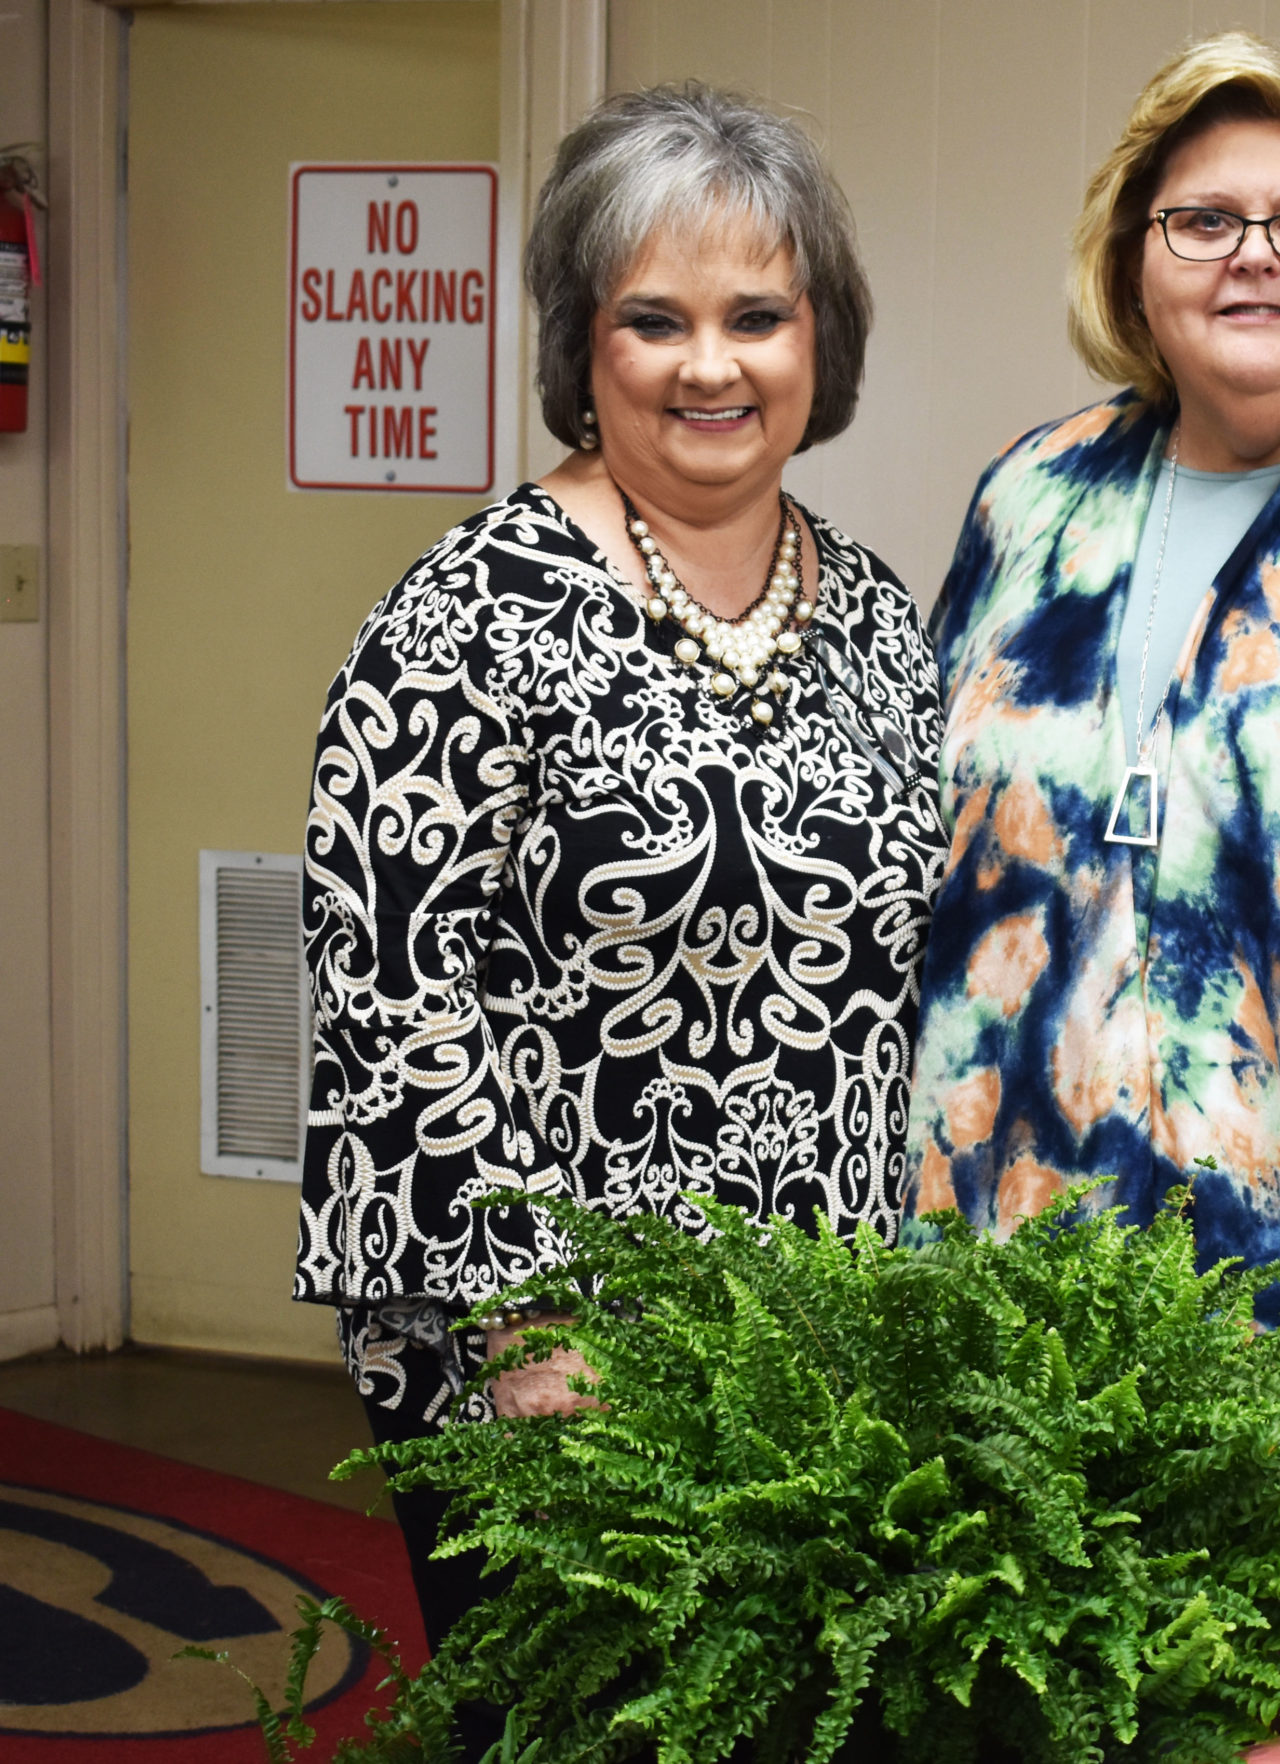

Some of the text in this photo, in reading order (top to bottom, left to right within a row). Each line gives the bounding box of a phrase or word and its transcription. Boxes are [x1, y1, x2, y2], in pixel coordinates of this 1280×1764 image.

[367, 199, 419, 255] NO
[301, 267, 485, 324] SLACKING
[352, 337, 431, 392] ANY
[344, 404, 438, 459] TIME
